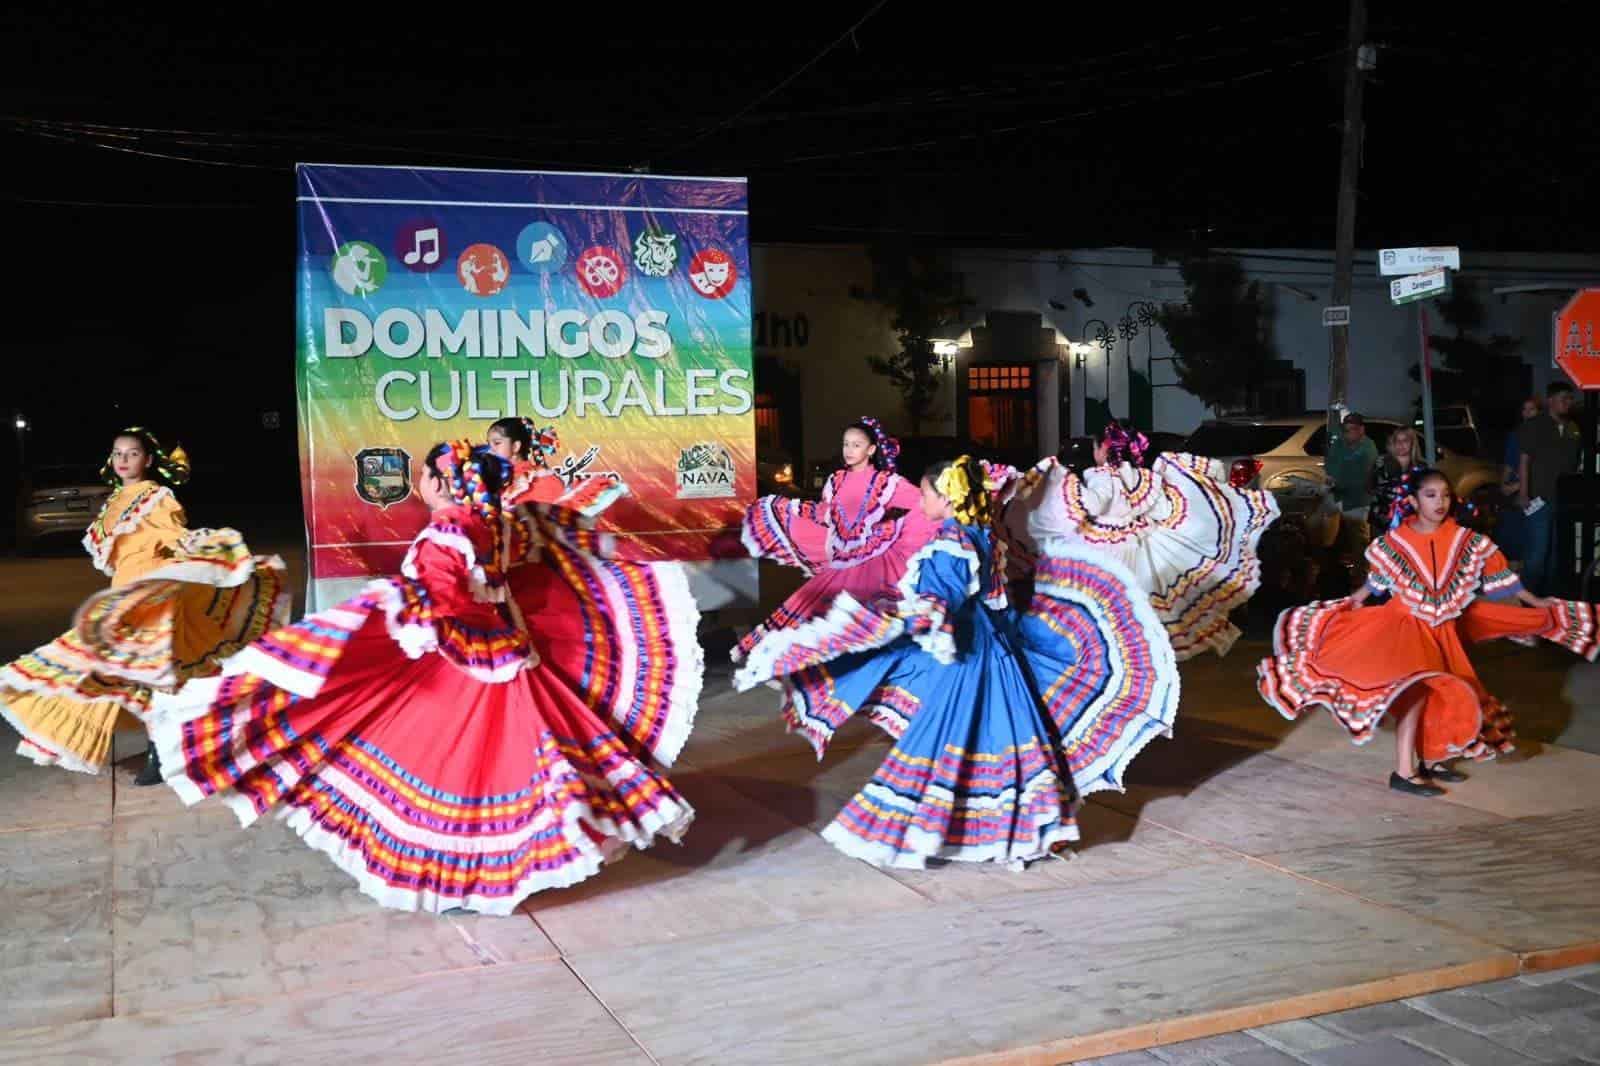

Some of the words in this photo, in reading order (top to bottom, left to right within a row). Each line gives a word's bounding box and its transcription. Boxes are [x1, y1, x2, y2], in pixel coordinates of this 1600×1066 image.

[324, 308, 672, 359] DOMINGOS
[375, 368, 752, 420] CULTURALES
[682, 471, 729, 485] NAVA
